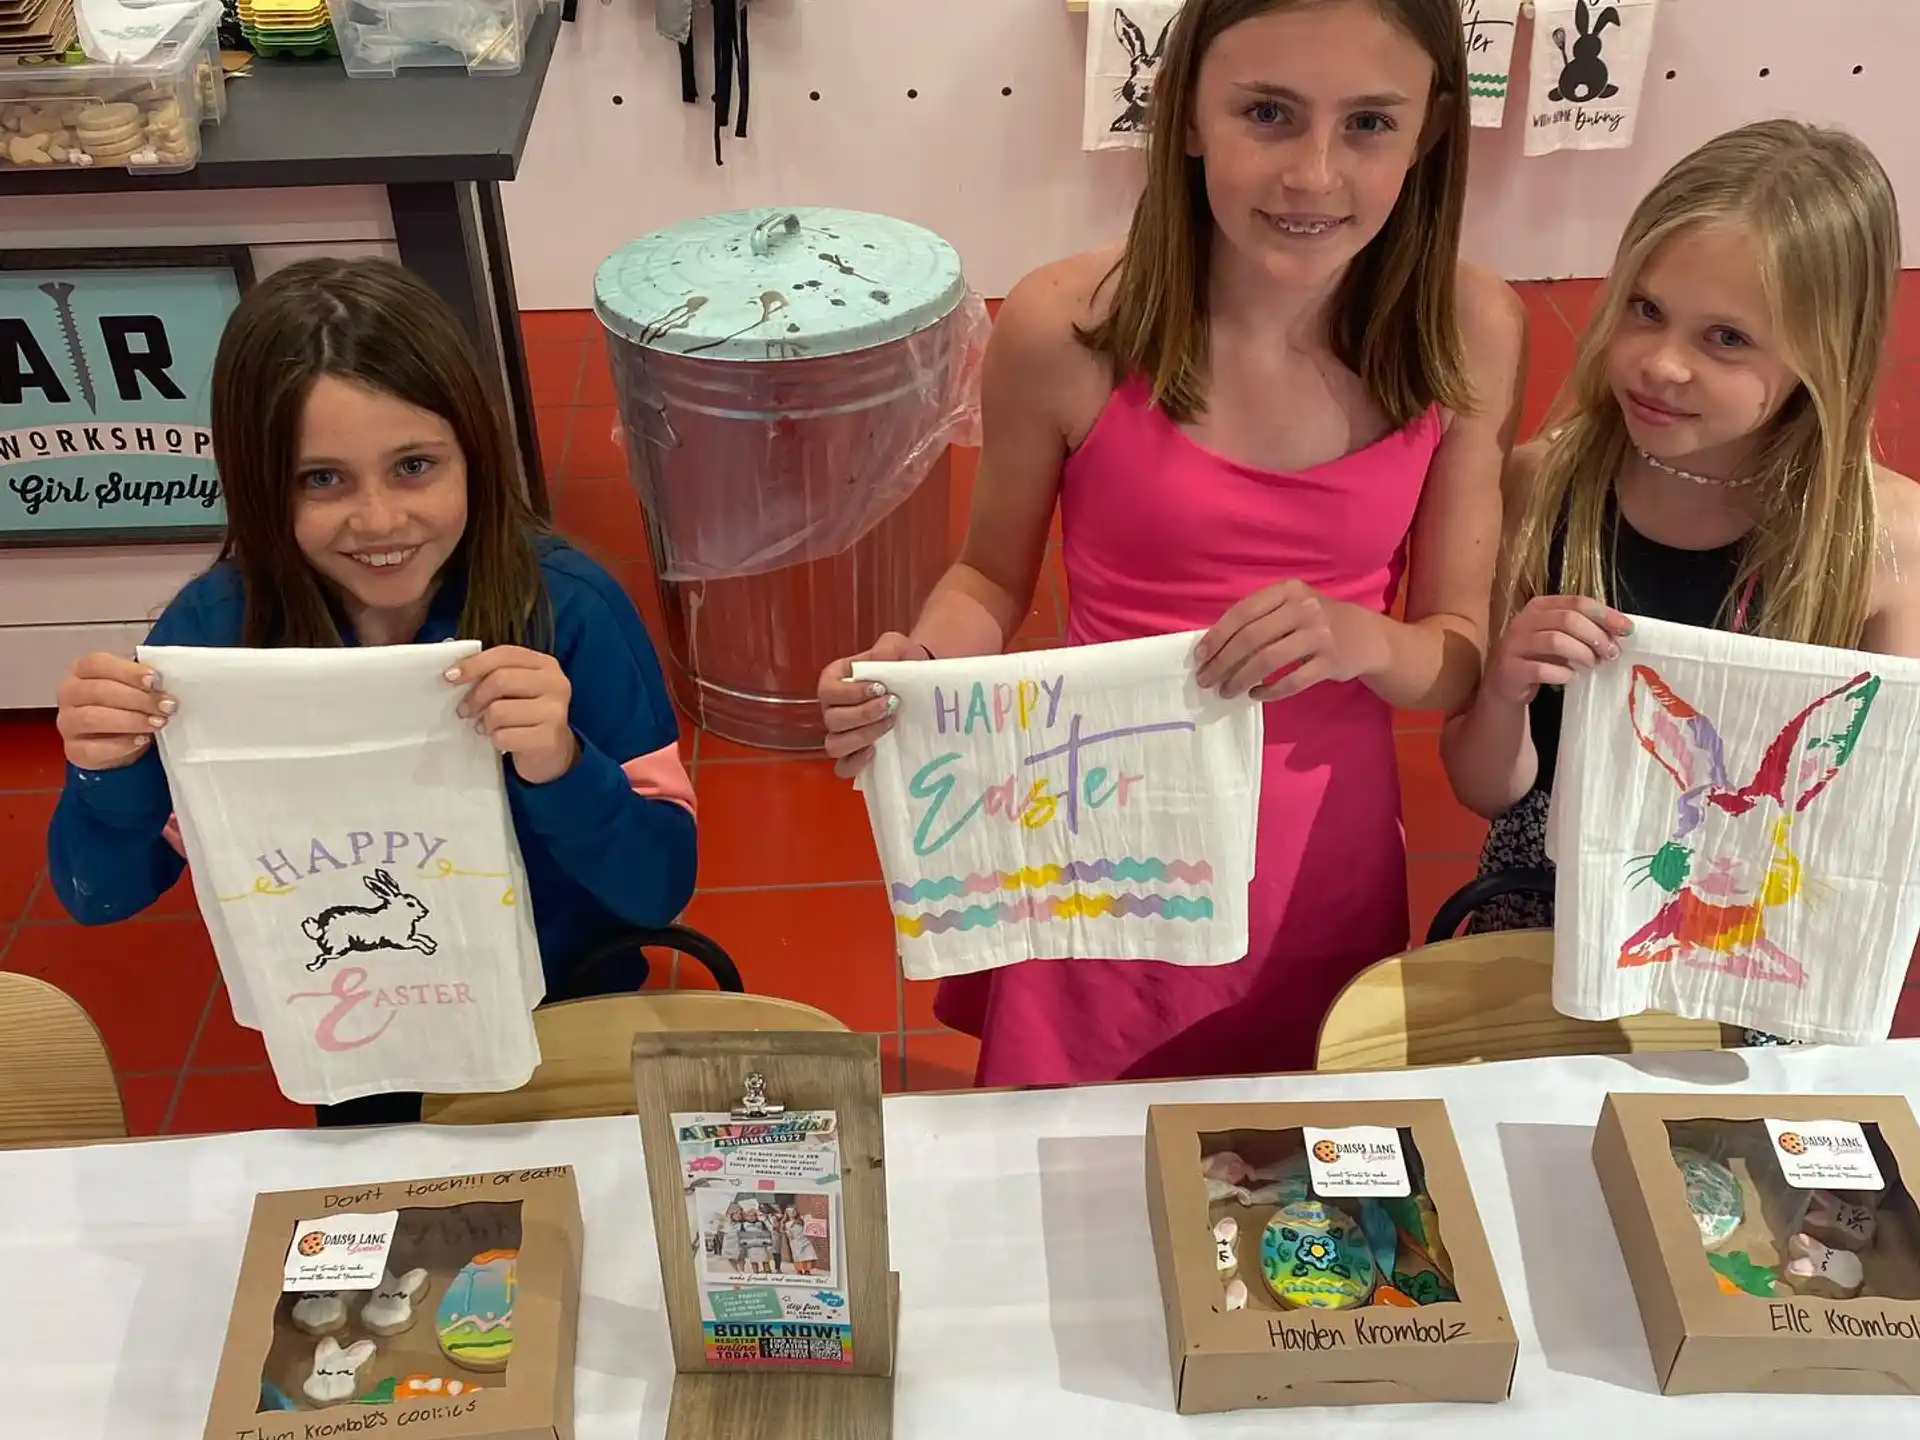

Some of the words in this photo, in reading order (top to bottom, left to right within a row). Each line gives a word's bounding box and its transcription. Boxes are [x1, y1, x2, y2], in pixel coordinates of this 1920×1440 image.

[0, 427, 210, 461] WORKSHOP
[9, 475, 89, 515] Girl
[95, 472, 222, 509] Supply
[935, 675, 1064, 735] HAPPY
[909, 714, 1196, 857] Easter
[257, 831, 448, 888] HAPPY
[1336, 1143, 1366, 1154] DAISY
[1370, 1143, 1396, 1154] LANE
[1802, 1136, 1832, 1149] DAISY
[1835, 1136, 1862, 1148] LANE
[323, 1186, 383, 1209] Don't
[405, 1175, 484, 1197] touch!!!
[493, 1172, 515, 1185] or
[520, 1166, 567, 1183] eat!!!
[324, 1233, 356, 1246] DAISY
[360, 1233, 388, 1245] LANE
[714, 1324, 775, 1337] BOOK
[782, 1324, 841, 1340] NOW!
[1267, 1318, 1345, 1351] Hayden
[1355, 1316, 1473, 1346] Krombolz
[1769, 1303, 1812, 1334] Elle
[1824, 1308, 1920, 1340] Krombol
[717, 1351, 757, 1360] TODAY
